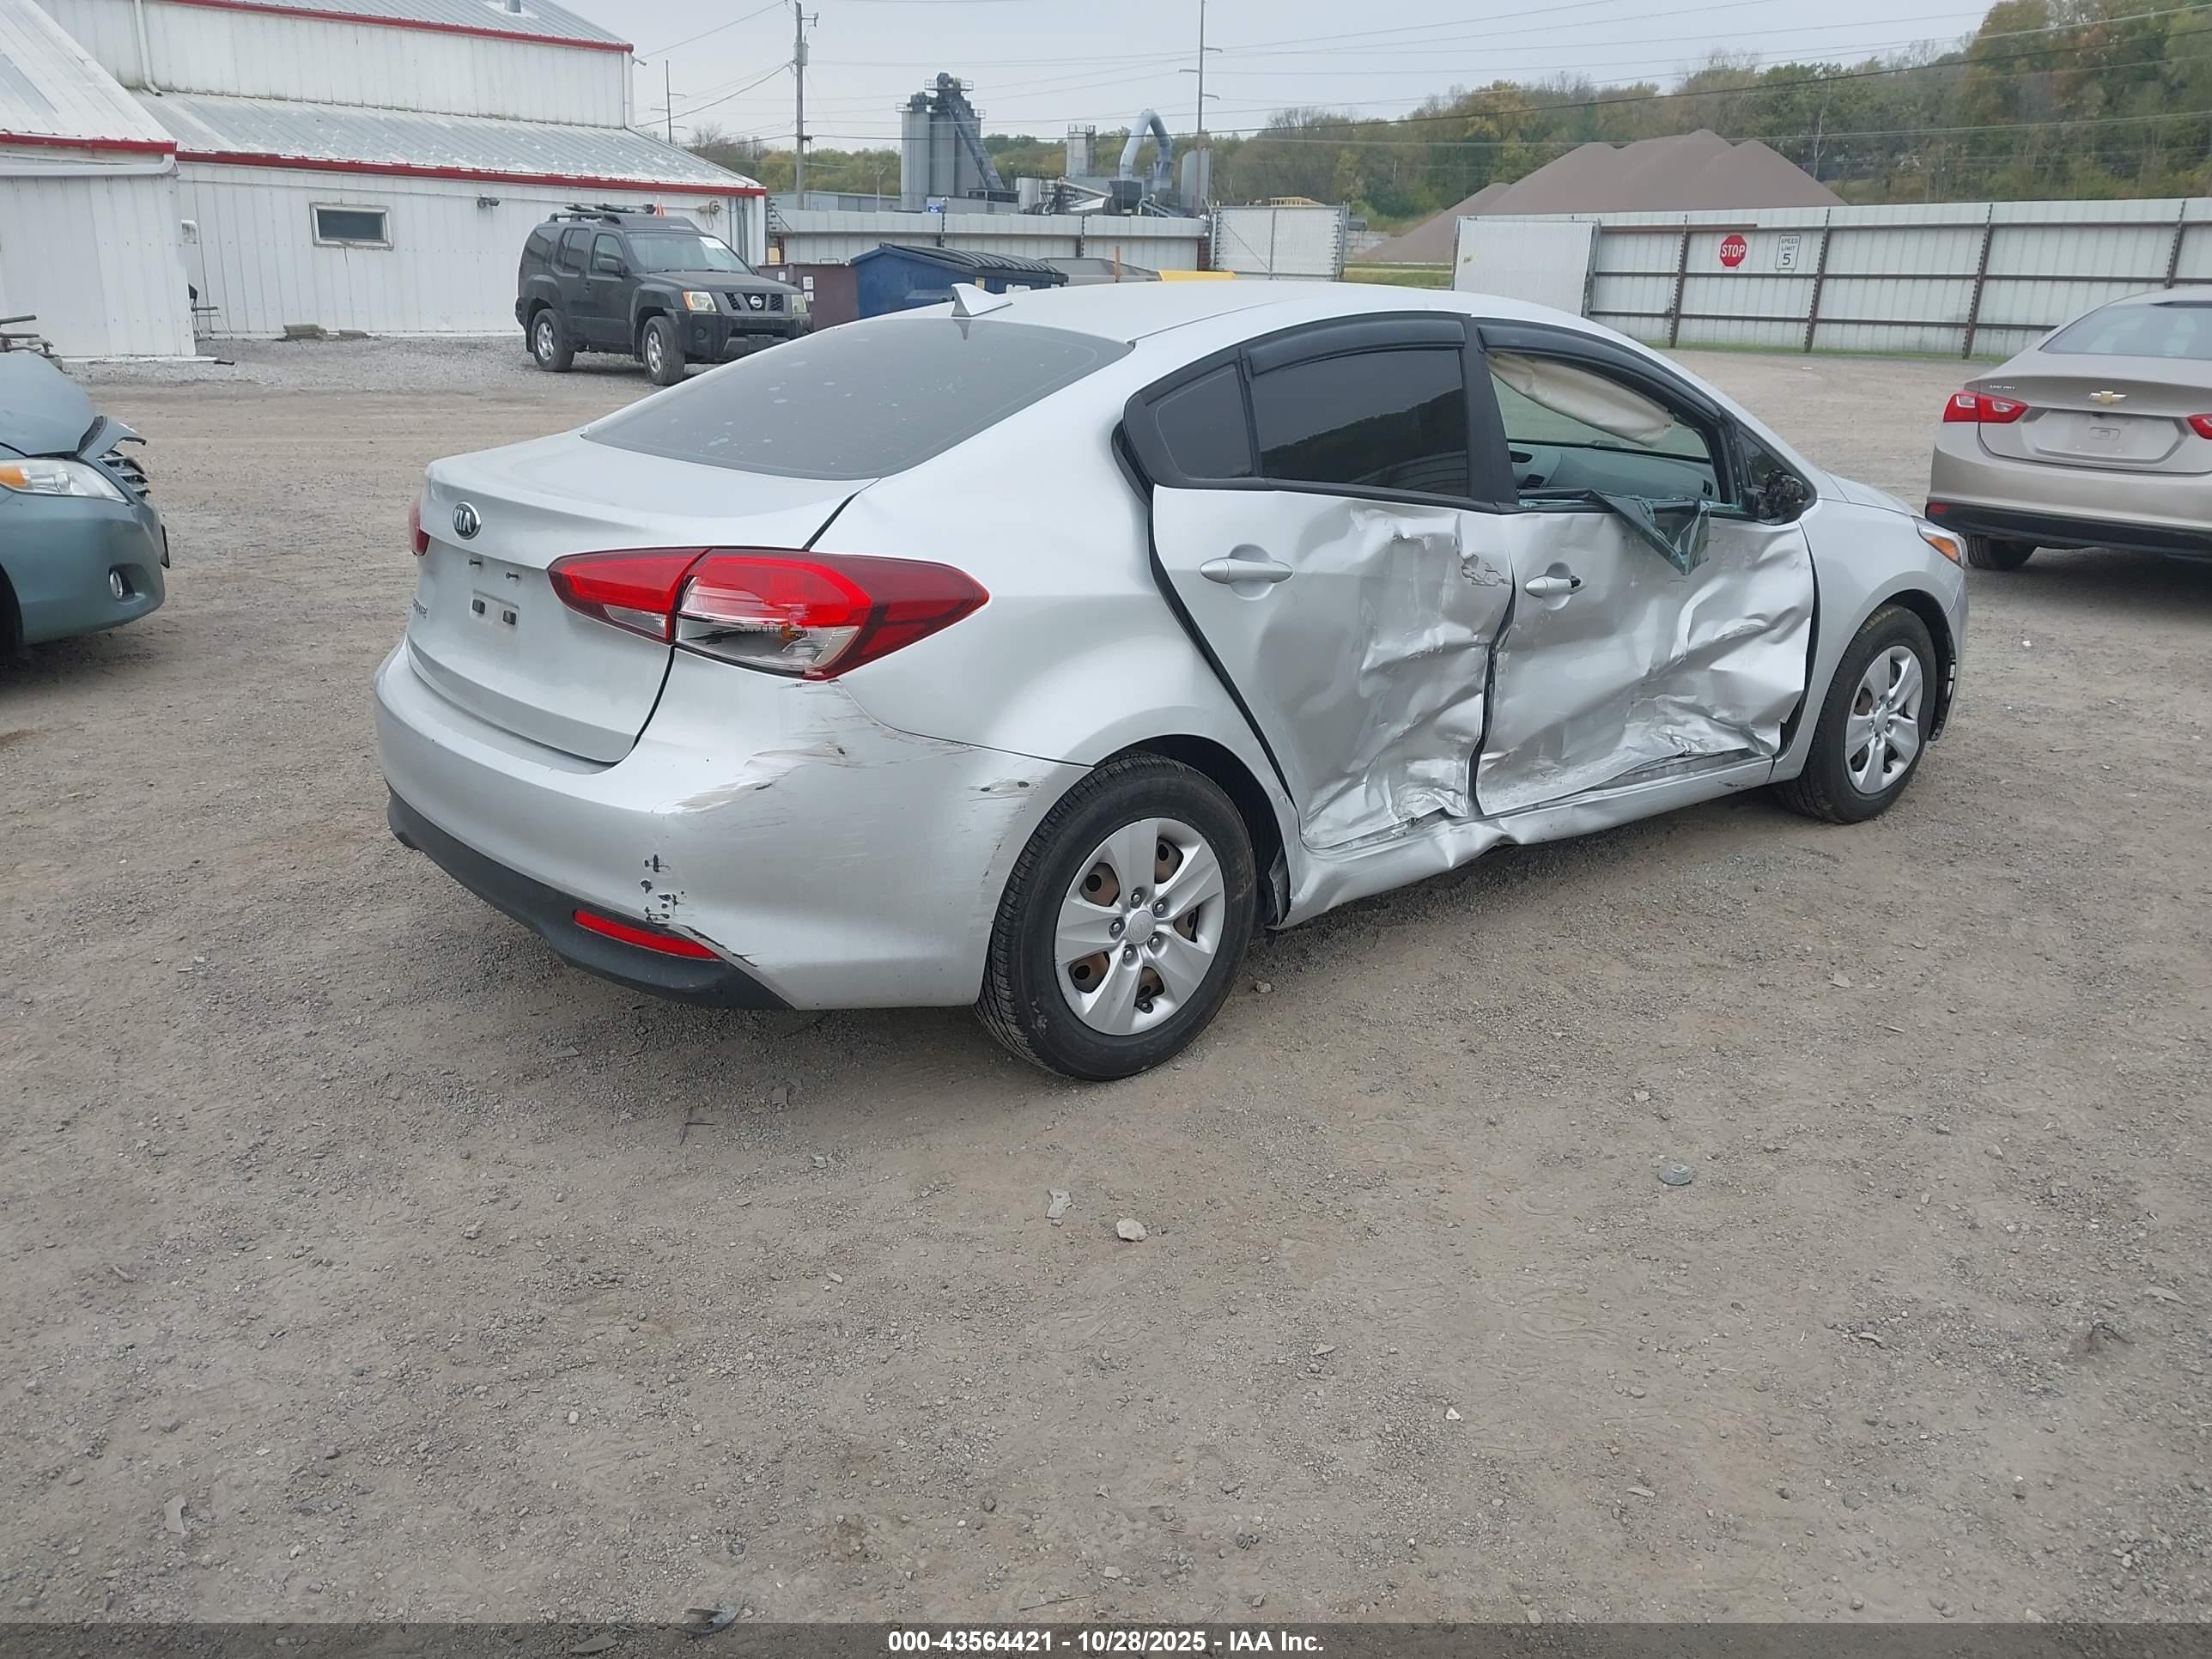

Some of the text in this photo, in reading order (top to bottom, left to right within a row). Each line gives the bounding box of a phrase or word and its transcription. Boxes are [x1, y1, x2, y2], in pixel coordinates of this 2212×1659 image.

[1722, 244, 1745, 257] STOP
[1783, 253, 1791, 265] 5
[454, 507, 472, 533] KIA
